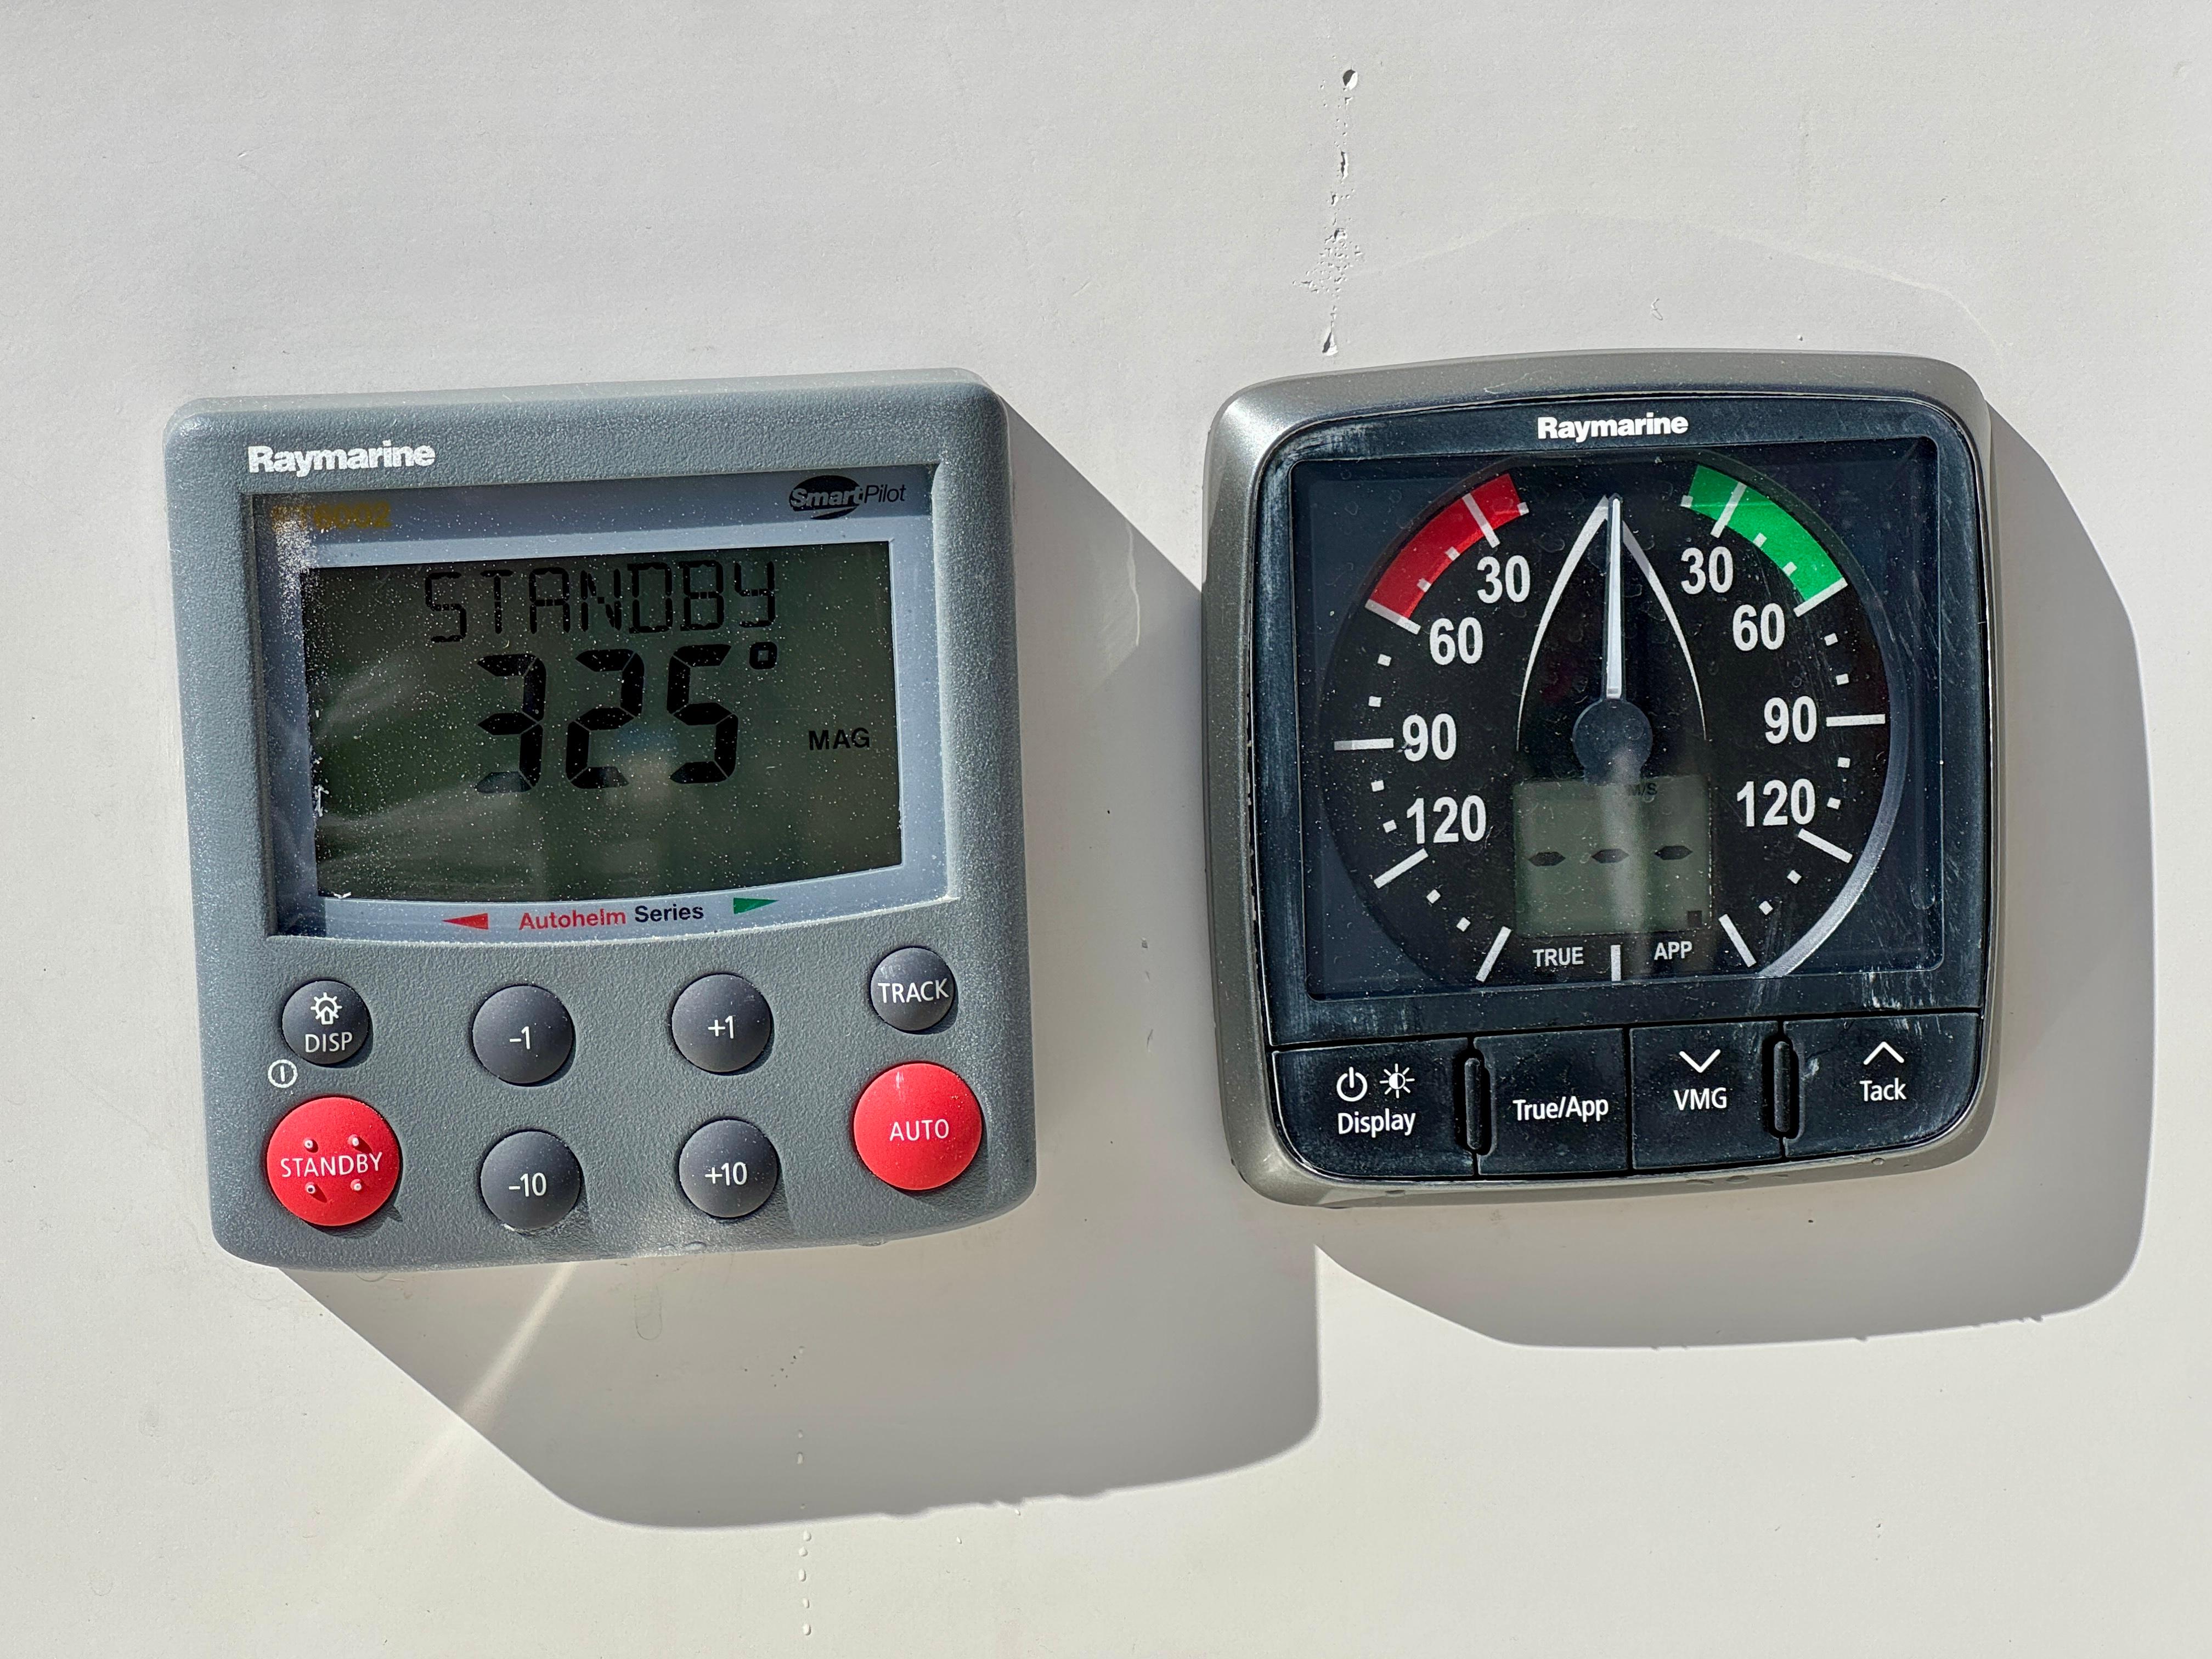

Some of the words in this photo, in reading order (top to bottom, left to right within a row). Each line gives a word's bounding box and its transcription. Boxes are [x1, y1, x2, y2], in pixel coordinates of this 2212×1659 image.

[1537, 411, 1689, 443] Raymarine
[247, 440, 437, 477] Raymarine
[788, 484, 907, 508] SmartPilot
[1477, 555, 1531, 604] 30
[1680, 546, 1734, 595] 30
[425, 559, 777, 644] STANDBY
[1732, 602, 1786, 651] 60
[1429, 617, 1483, 665] 60
[1763, 696, 1818, 744] 90
[808, 727, 871, 751] MAG
[1402, 713, 1457, 762] 90
[1736, 778, 1816, 827] 120
[1406, 794, 1487, 845] 120
[519, 909, 627, 930] Autohelm
[634, 903, 704, 923] Series
[1532, 946, 1584, 967] TRUE
[1654, 941, 1693, 961] APP
[878, 978, 950, 1004] TRACK
[509, 1026, 531, 1049] -1
[708, 1015, 735, 1039] +1
[304, 1031, 353, 1053] DISP
[1673, 1087, 1728, 1110] VMG
[1859, 1077, 1907, 1102] Tack
[1513, 1096, 1609, 1122] True/App
[889, 1119, 950, 1142] AUTO
[1338, 1108, 1416, 1138] Display
[280, 1152, 383, 1178] STANDBY
[704, 1162, 748, 1186] +10
[509, 1173, 547, 1197] -10
